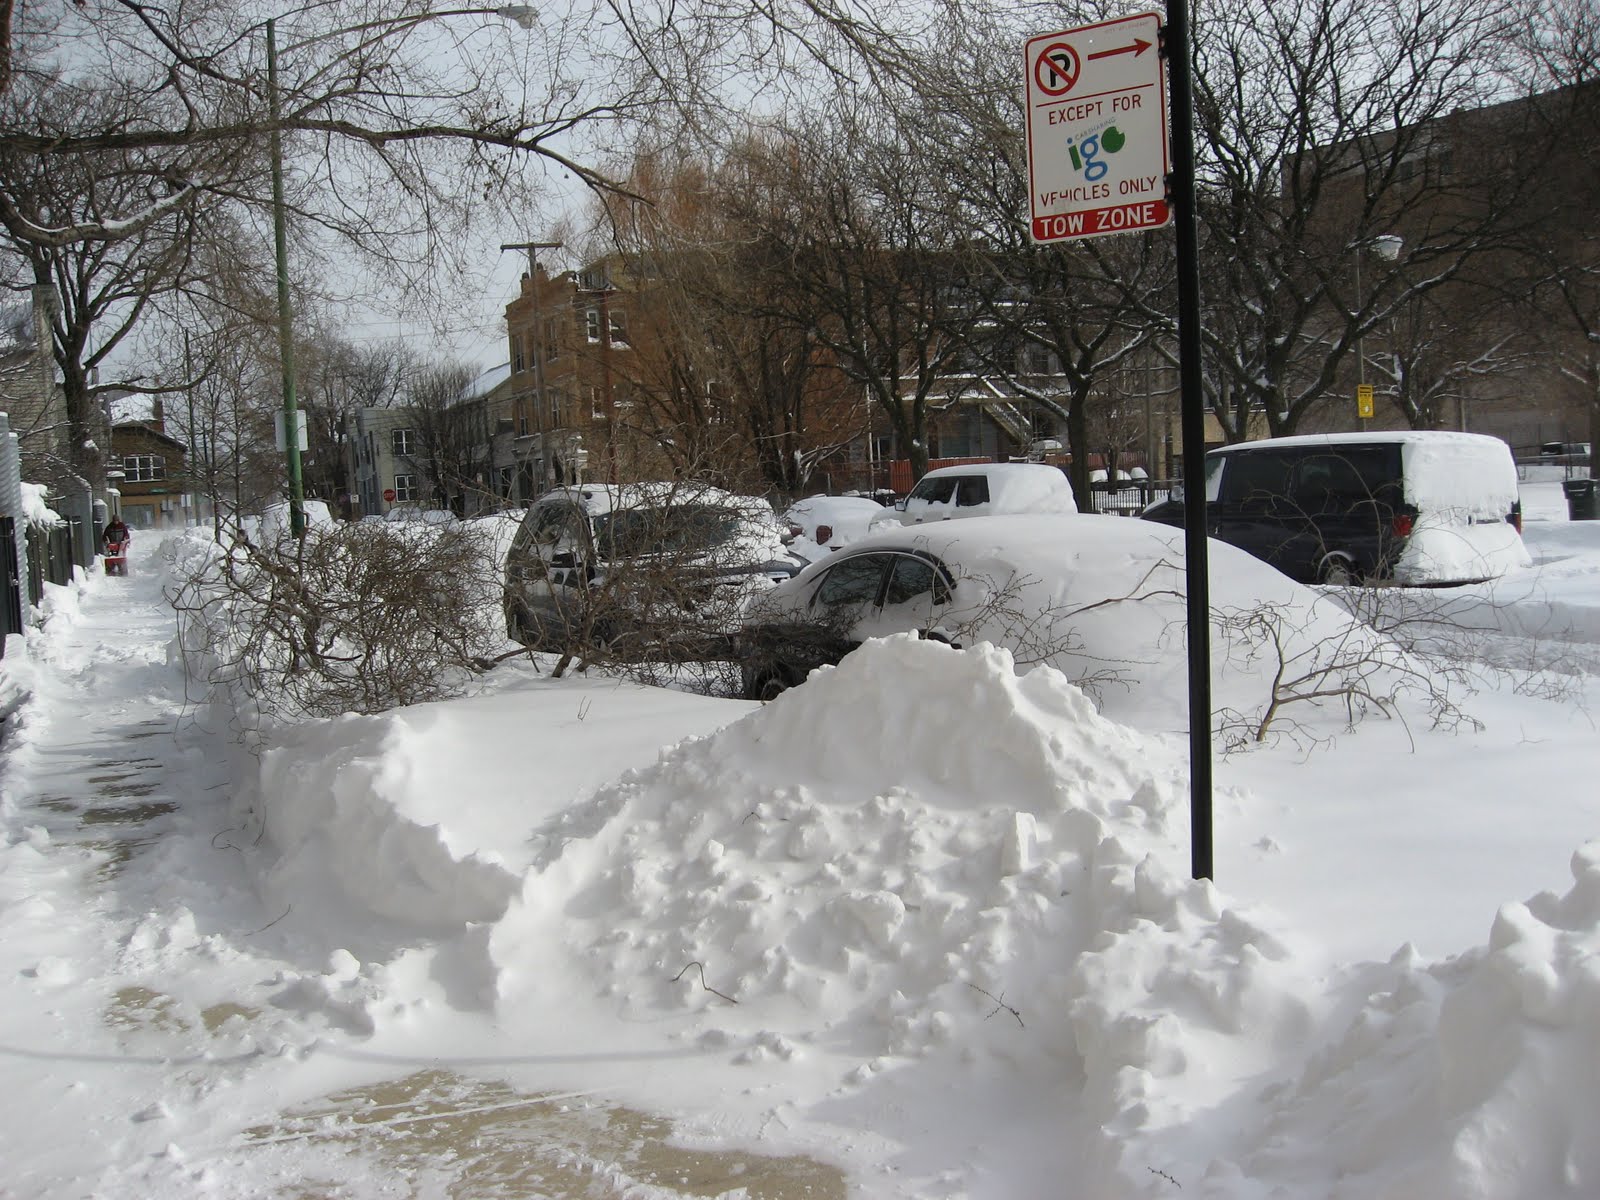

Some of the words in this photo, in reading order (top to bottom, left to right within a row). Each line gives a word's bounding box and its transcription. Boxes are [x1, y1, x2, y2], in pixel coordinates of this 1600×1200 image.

[1048, 101, 1103, 125] EXCEPT
[1113, 94, 1142, 113] FOR
[1120, 176, 1157, 195] ONLY
[1041, 214, 1085, 237] TOW
[1097, 204, 1156, 230] ZONE
